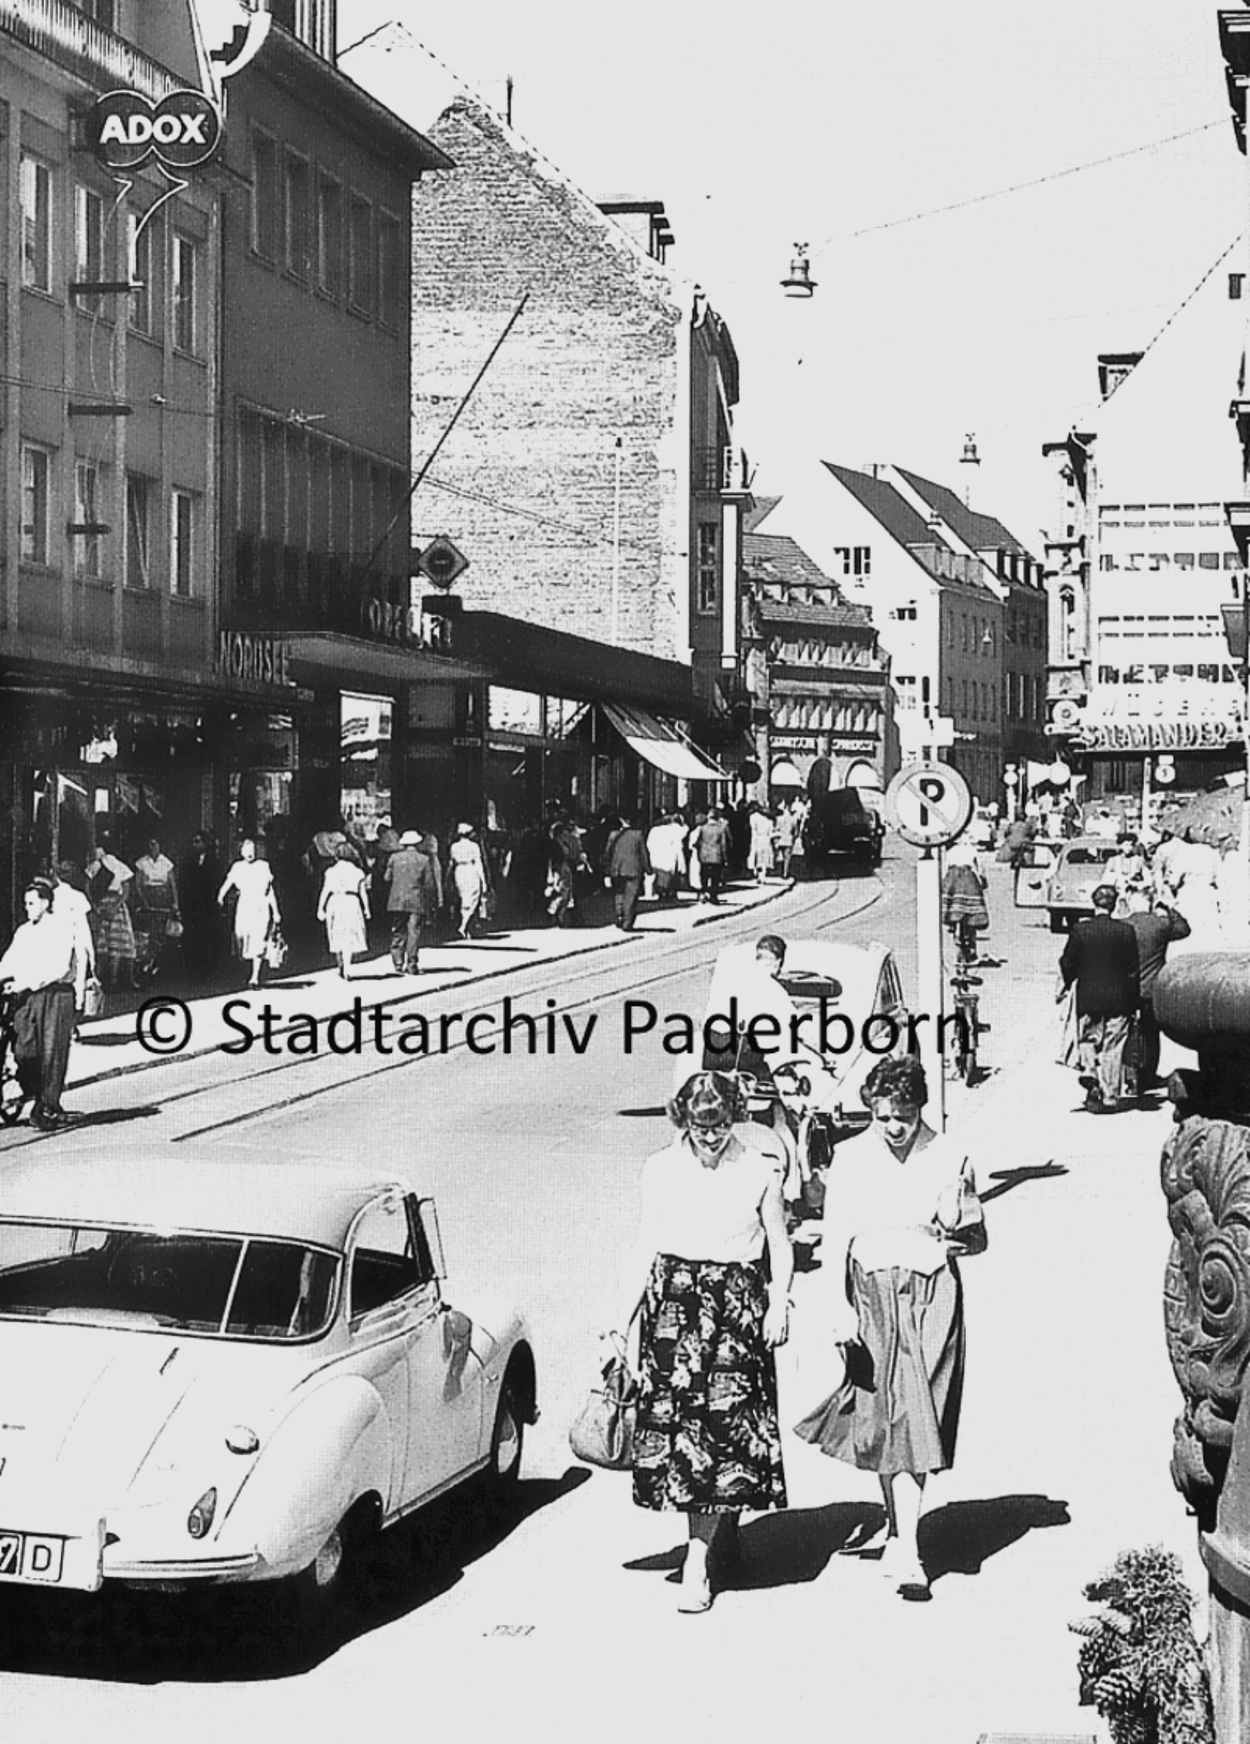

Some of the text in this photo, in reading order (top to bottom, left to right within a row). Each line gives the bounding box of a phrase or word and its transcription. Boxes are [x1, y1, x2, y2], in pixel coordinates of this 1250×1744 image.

[99, 113, 207, 145] ADOX
[1081, 720, 1229, 750] SALAMANDER
[919, 778, 946, 827] P
